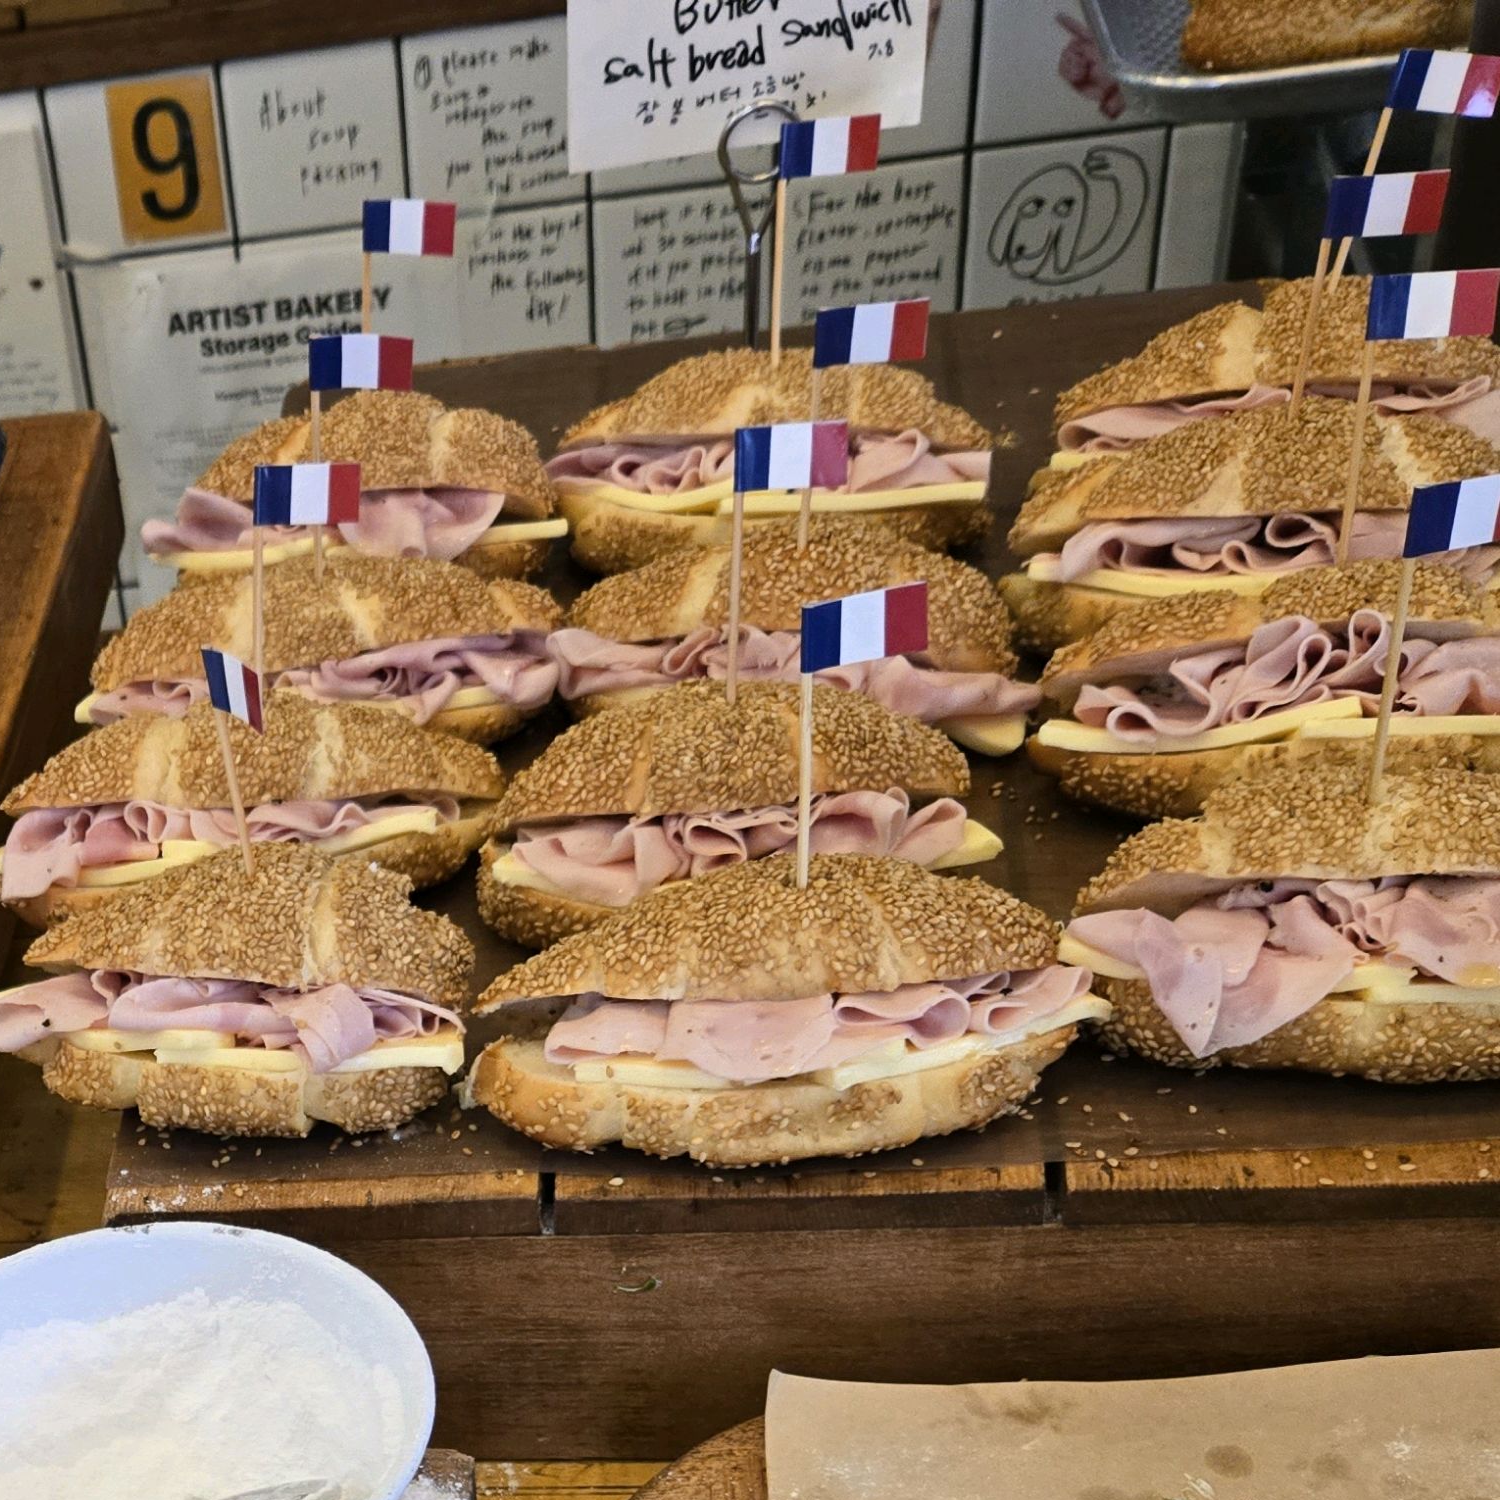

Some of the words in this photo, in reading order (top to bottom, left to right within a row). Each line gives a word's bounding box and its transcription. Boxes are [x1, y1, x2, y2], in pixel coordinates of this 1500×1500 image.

[688, 23, 766, 82] bread
[867, 38, 894, 61] 7.8
[442, 50, 498, 88] please
[307, 125, 360, 152] soup
[131, 97, 200, 221] 9
[299, 158, 382, 197] packing
[168, 300, 267, 337] ARTIST
[200, 331, 290, 357] Storage
